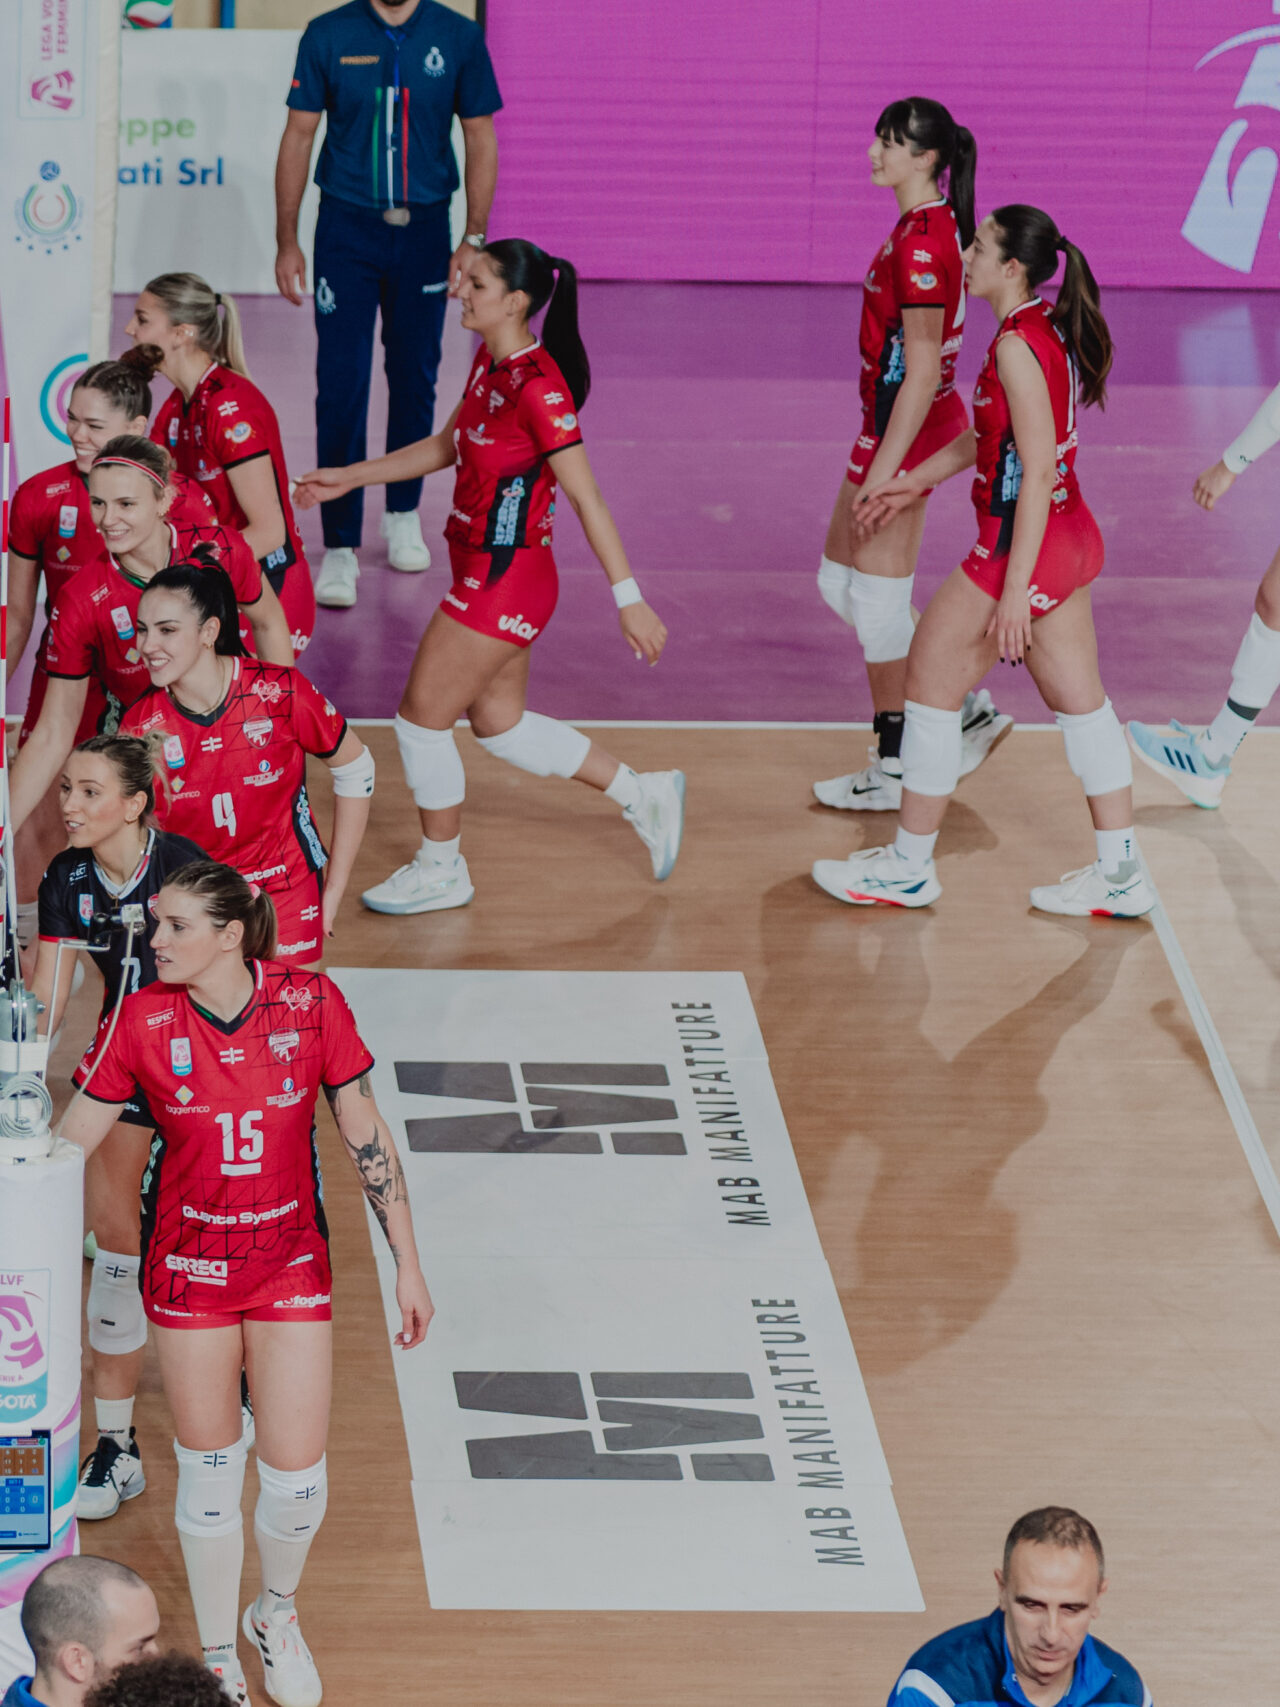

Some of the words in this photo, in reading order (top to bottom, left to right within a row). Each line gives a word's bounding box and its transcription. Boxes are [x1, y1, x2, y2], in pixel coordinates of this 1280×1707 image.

[117, 118, 196, 146] ppe
[178, 156, 223, 185] Srl
[211, 792, 237, 838] 4
[146, 1011, 175, 1026] RESPECT
[671, 1001, 754, 1162] MANIFATTURE
[215, 1110, 264, 1162] 15
[182, 1205, 237, 1225] Quanta
[238, 1199, 299, 1225] System
[717, 1175, 772, 1227] MAB
[0, 1274, 25, 1287] LVF
[165, 1254, 228, 1278] ERRECI
[751, 1298, 845, 1489] MANIFATTURE
[805, 1506, 866, 1567] MAB
